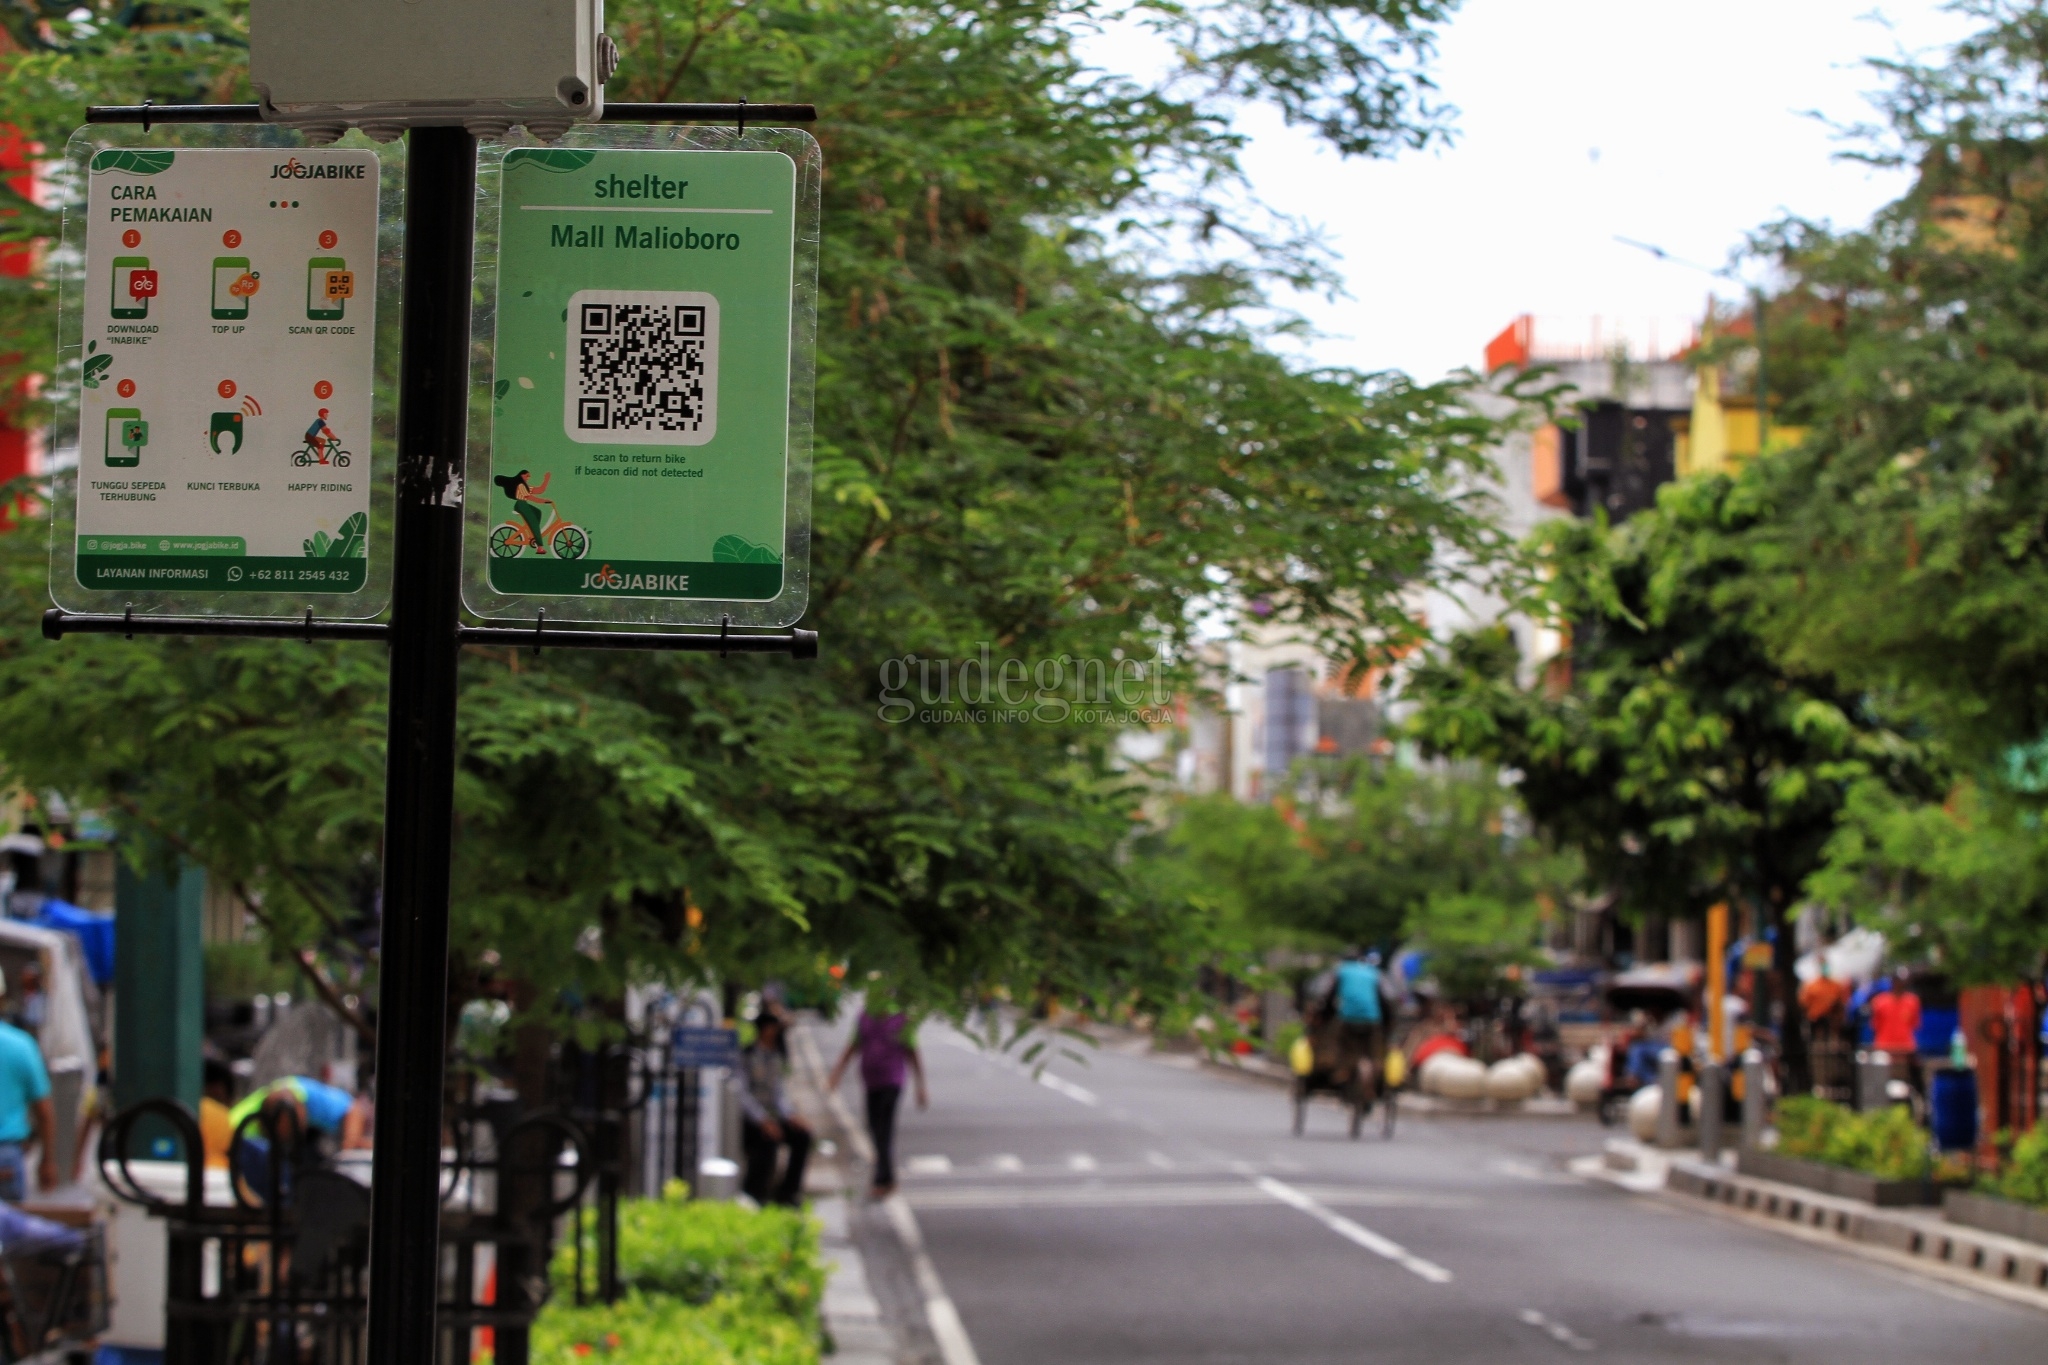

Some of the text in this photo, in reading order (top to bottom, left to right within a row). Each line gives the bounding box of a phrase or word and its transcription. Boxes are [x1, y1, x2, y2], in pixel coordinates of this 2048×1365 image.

[271, 158, 365, 179] JOGJABIKE
[595, 173, 688, 200] shelter
[111, 185, 157, 201] CARA
[110, 207, 213, 223] PEMAKAIAN
[130, 234, 134, 243] 1
[230, 235, 236, 243] 2
[325, 235, 331, 244] 3
[549, 224, 739, 251] Mall Malioboro
[106, 325, 160, 335] DOWNLOAD
[211, 326, 230, 334] TOP
[288, 326, 313, 335] SCAN
[331, 326, 355, 335] CODE
[123, 384, 129, 392] 4
[225, 385, 231, 393] 5
[321, 386, 327, 394] 6
[619, 454, 628, 462] to
[632, 454, 661, 462] return
[665, 454, 685, 463] bike
[575, 466, 703, 478] if beacon did not detected
[91, 481, 165, 491] TUNGGU SEPEDA
[186, 483, 259, 492] KUNCI TERBUKA
[321, 484, 352, 493] RIDING
[99, 491, 157, 502] TERHUBUNG
[101, 540, 239, 551] @jogja.bike www.jogjabike.id
[97, 567, 209, 579] LAYANAN INFORMASI
[250, 570, 349, 580] +62 811 2545 432
[581, 564, 689, 590] JOGJABIKE
